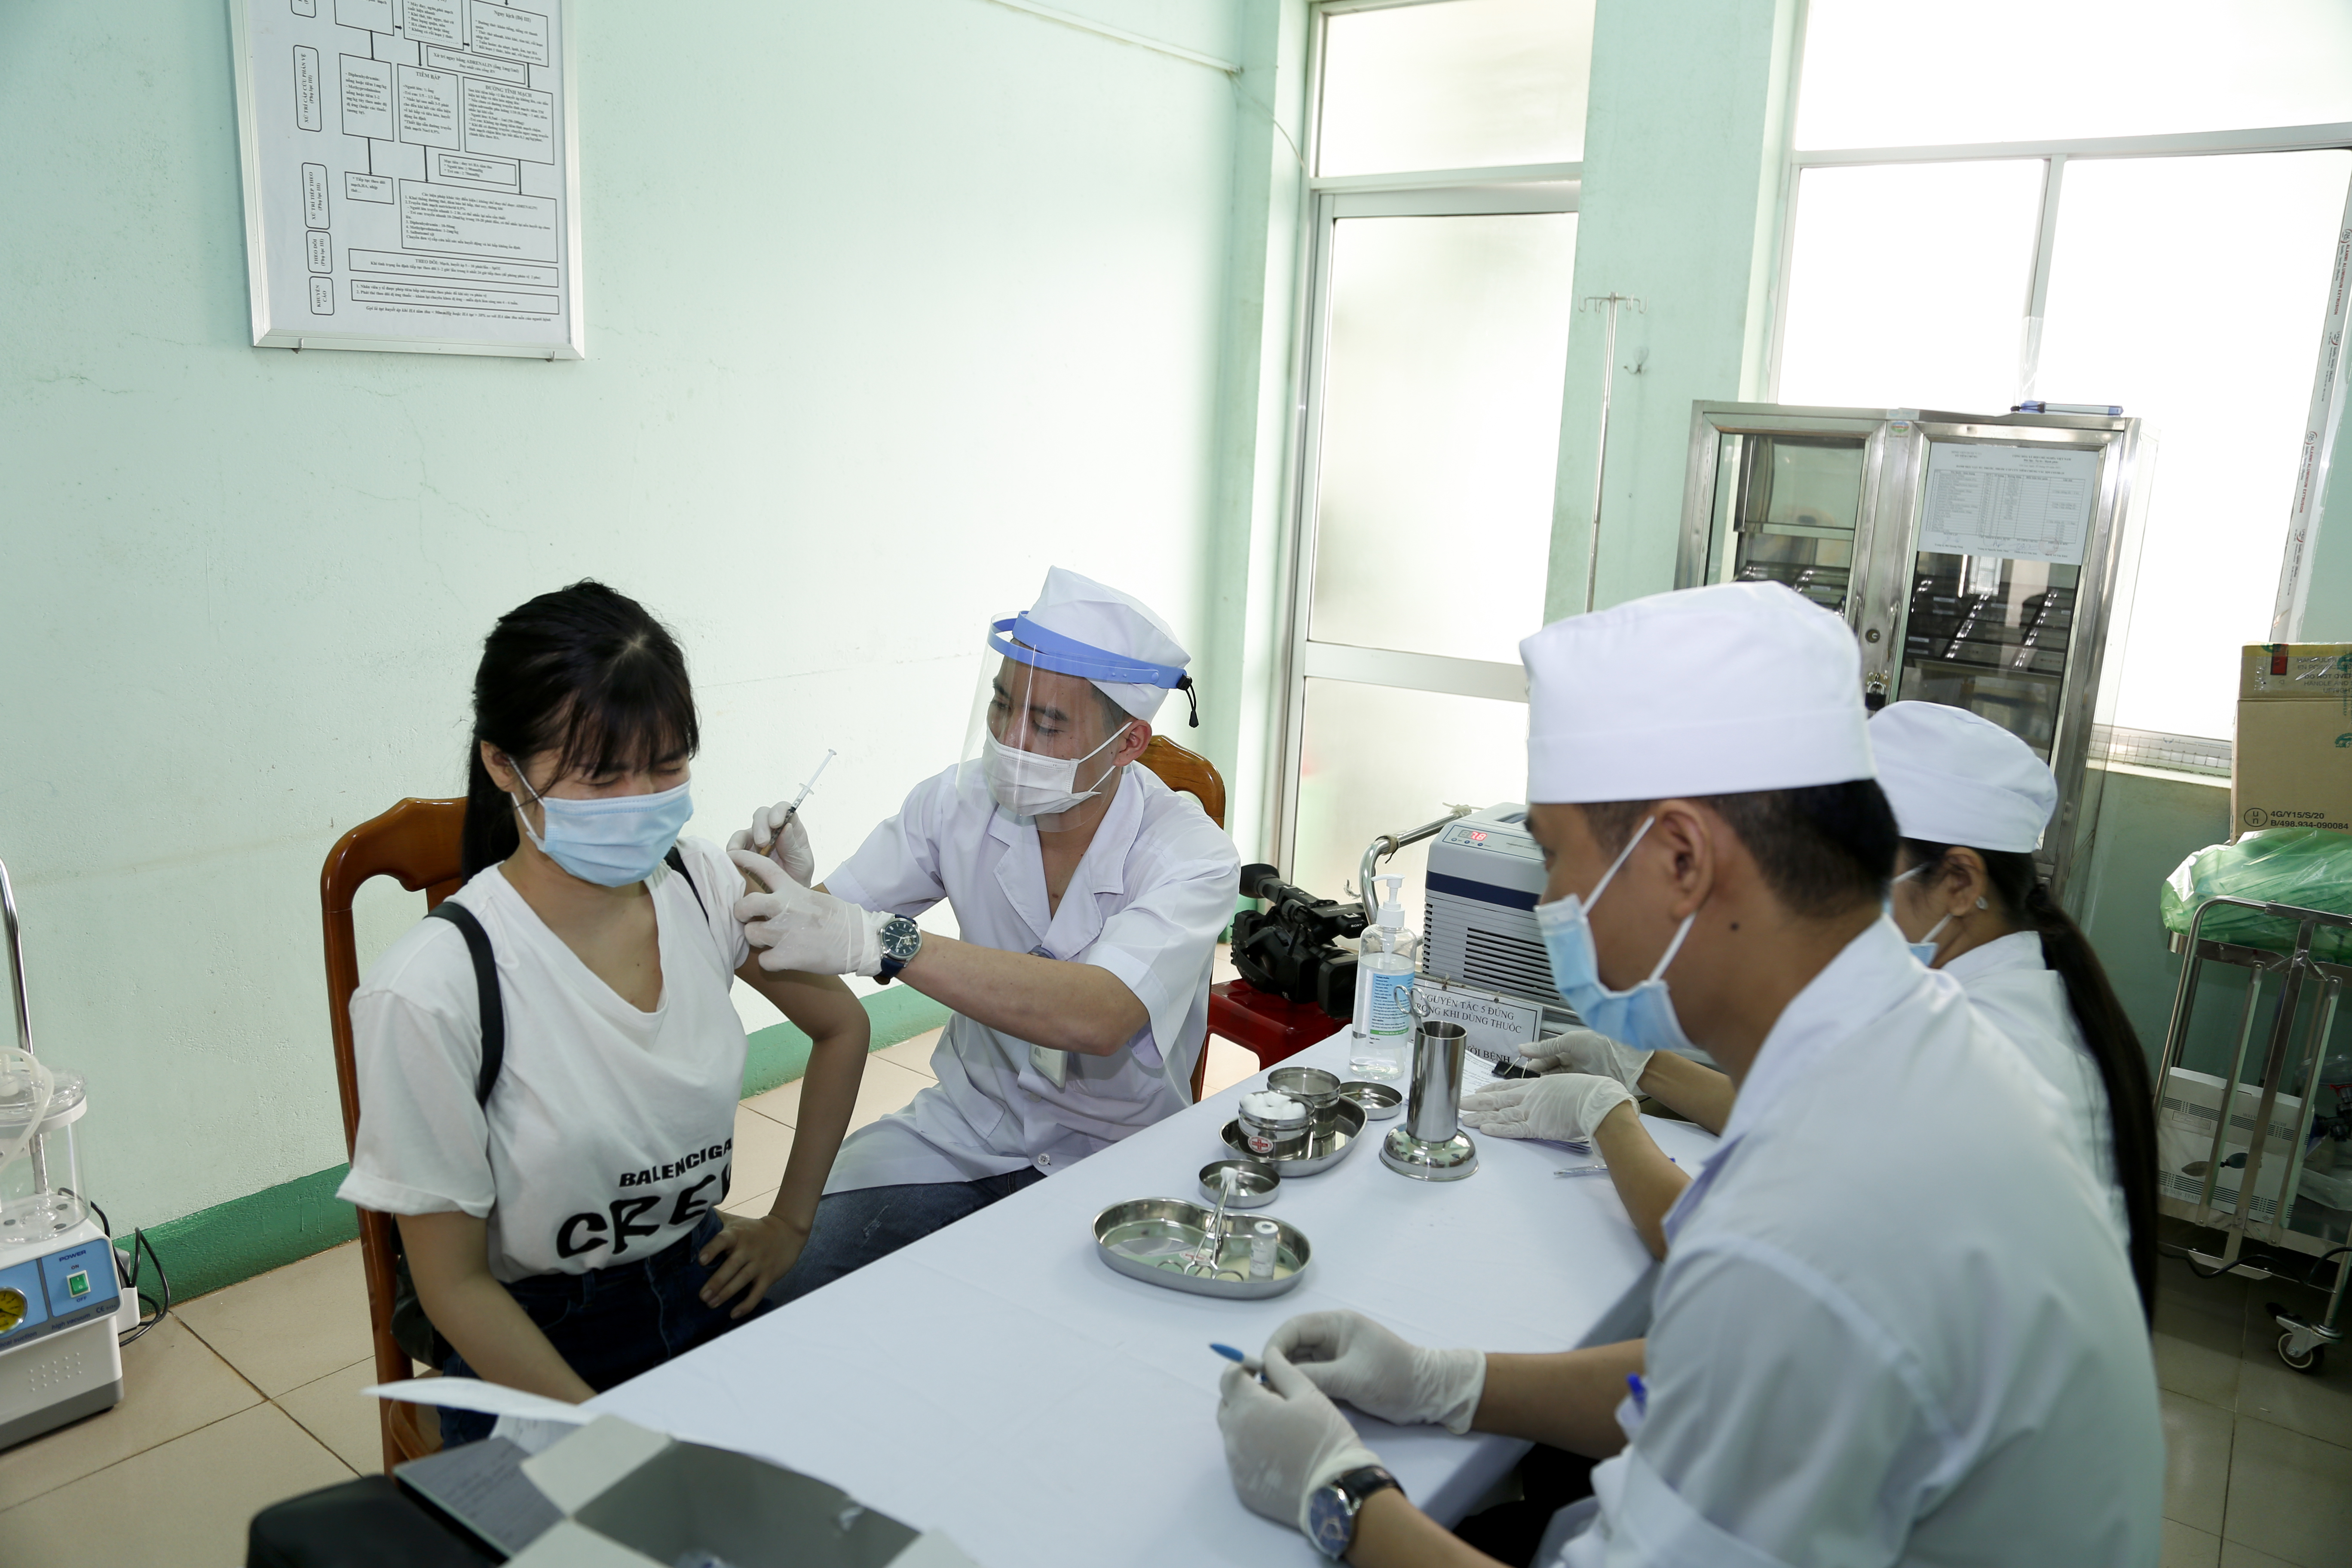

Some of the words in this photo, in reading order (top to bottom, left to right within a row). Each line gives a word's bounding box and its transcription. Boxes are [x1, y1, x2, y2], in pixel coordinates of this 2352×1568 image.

[2334, 289, 2342, 315] EXTRUSION
[2270, 811, 2324, 819] 4G/Y15/S/20
[2270, 820, 2349, 830] B/498.934-090084
[1421, 994, 1458, 1007] NGUYÊN
[1460, 1001, 1479, 1012] TẮC
[1488, 1007, 1514, 1020] ĐÚNG
[1443, 1010, 1460, 1019] KHI
[1462, 1012, 1488, 1025] DÙNG
[1491, 1019, 1522, 1033] THUỐC
[619, 1138, 732, 1187] BALENCIGA
[2163, 1187, 2201, 1201] RESUSCITATO
[59, 1250, 86, 1262] POWER
[52, 1322, 65, 1330] high
[67, 1314, 90, 1325] vacuum
[13, 1331, 37, 1343] suction
